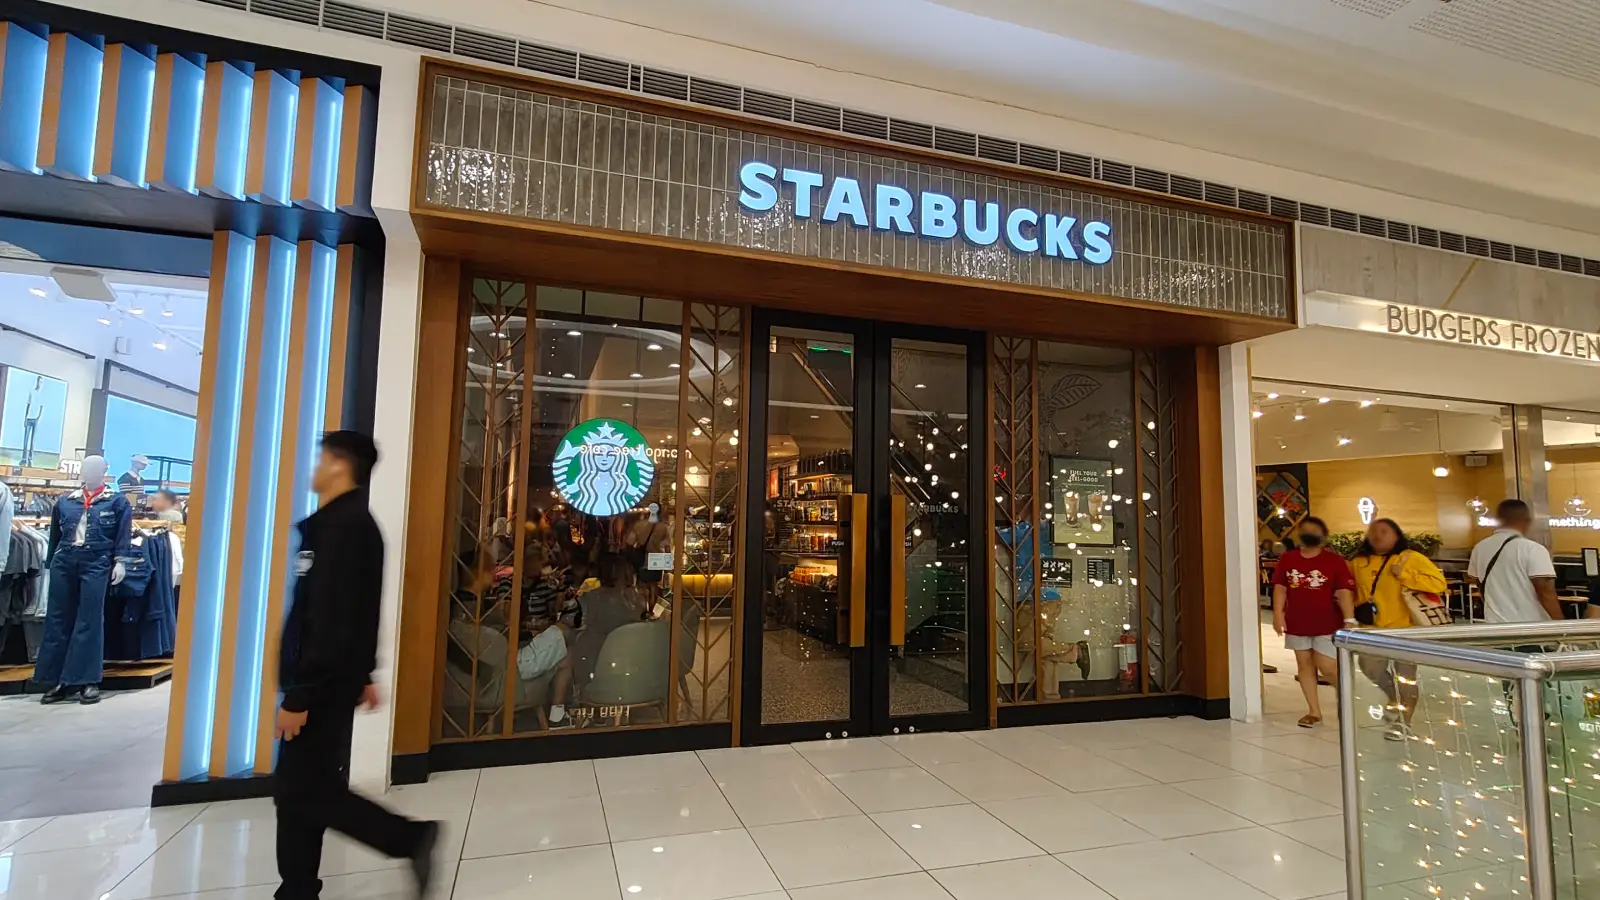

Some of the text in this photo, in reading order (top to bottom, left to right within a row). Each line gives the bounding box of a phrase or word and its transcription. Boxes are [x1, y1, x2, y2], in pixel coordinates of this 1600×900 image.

[739, 162, 1113, 265] STARBUCKS
[1387, 304, 1600, 360] BURGERS FROZEN
[60, 459, 82, 475] STR
